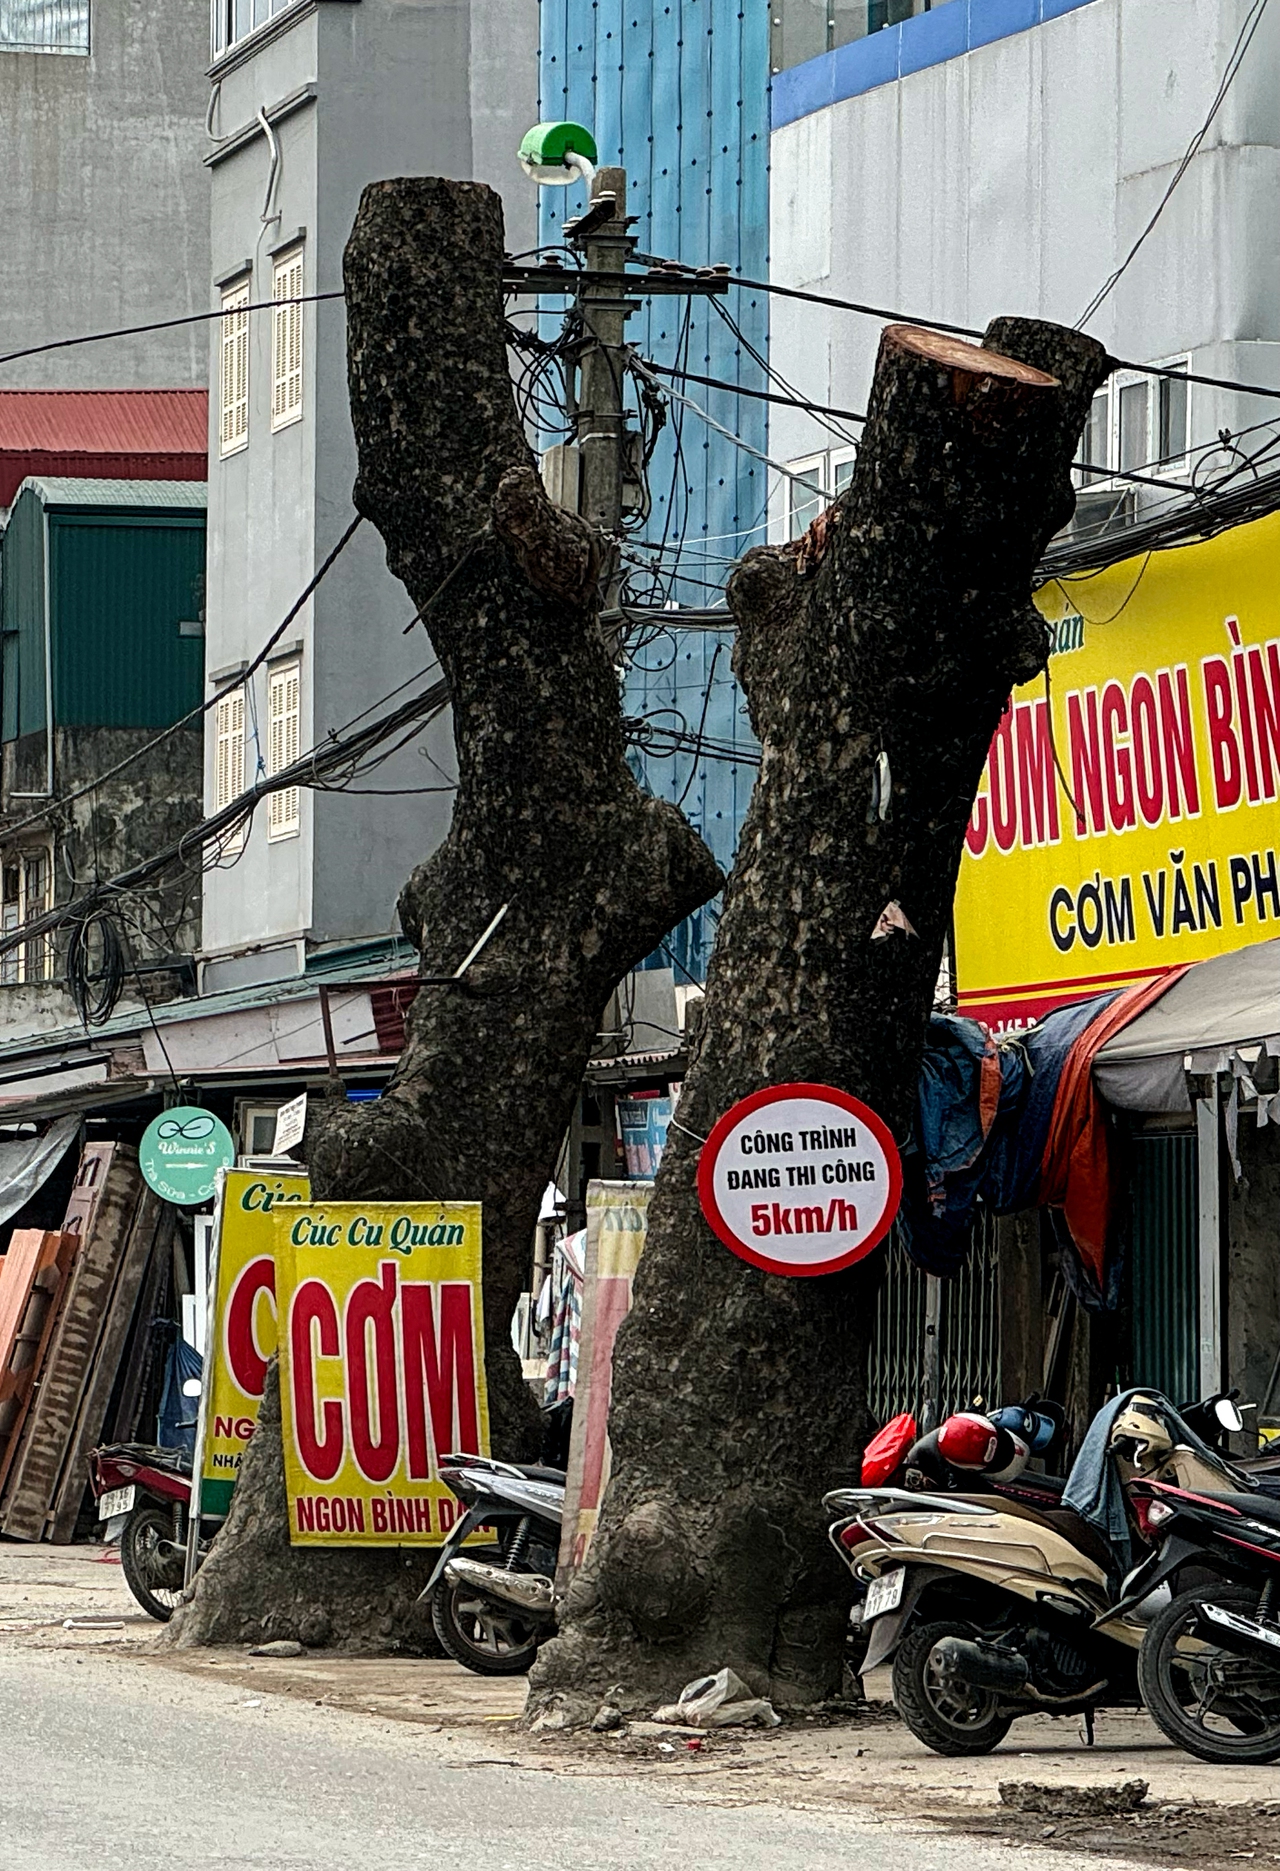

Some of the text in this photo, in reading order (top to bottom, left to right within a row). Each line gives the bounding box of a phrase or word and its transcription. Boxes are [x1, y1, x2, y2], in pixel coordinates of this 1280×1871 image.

[1067, 667, 1201, 838] NGON
[1202, 619, 1280, 809] BÌN
[1050, 850, 1280, 952] CƠM VĂN PH
[740, 1125, 857, 1155] CÔNG TRÌNH
[727, 1158, 876, 1190] ĐANG THI CÔNG
[291, 1214, 465, 1255] Cúc Cu Quán
[750, 1198, 859, 1237] 5km/h
[291, 1262, 480, 1482] CƠM
[296, 1496, 365, 1533] NGON
[371, 1490, 432, 1533] BÌNH
